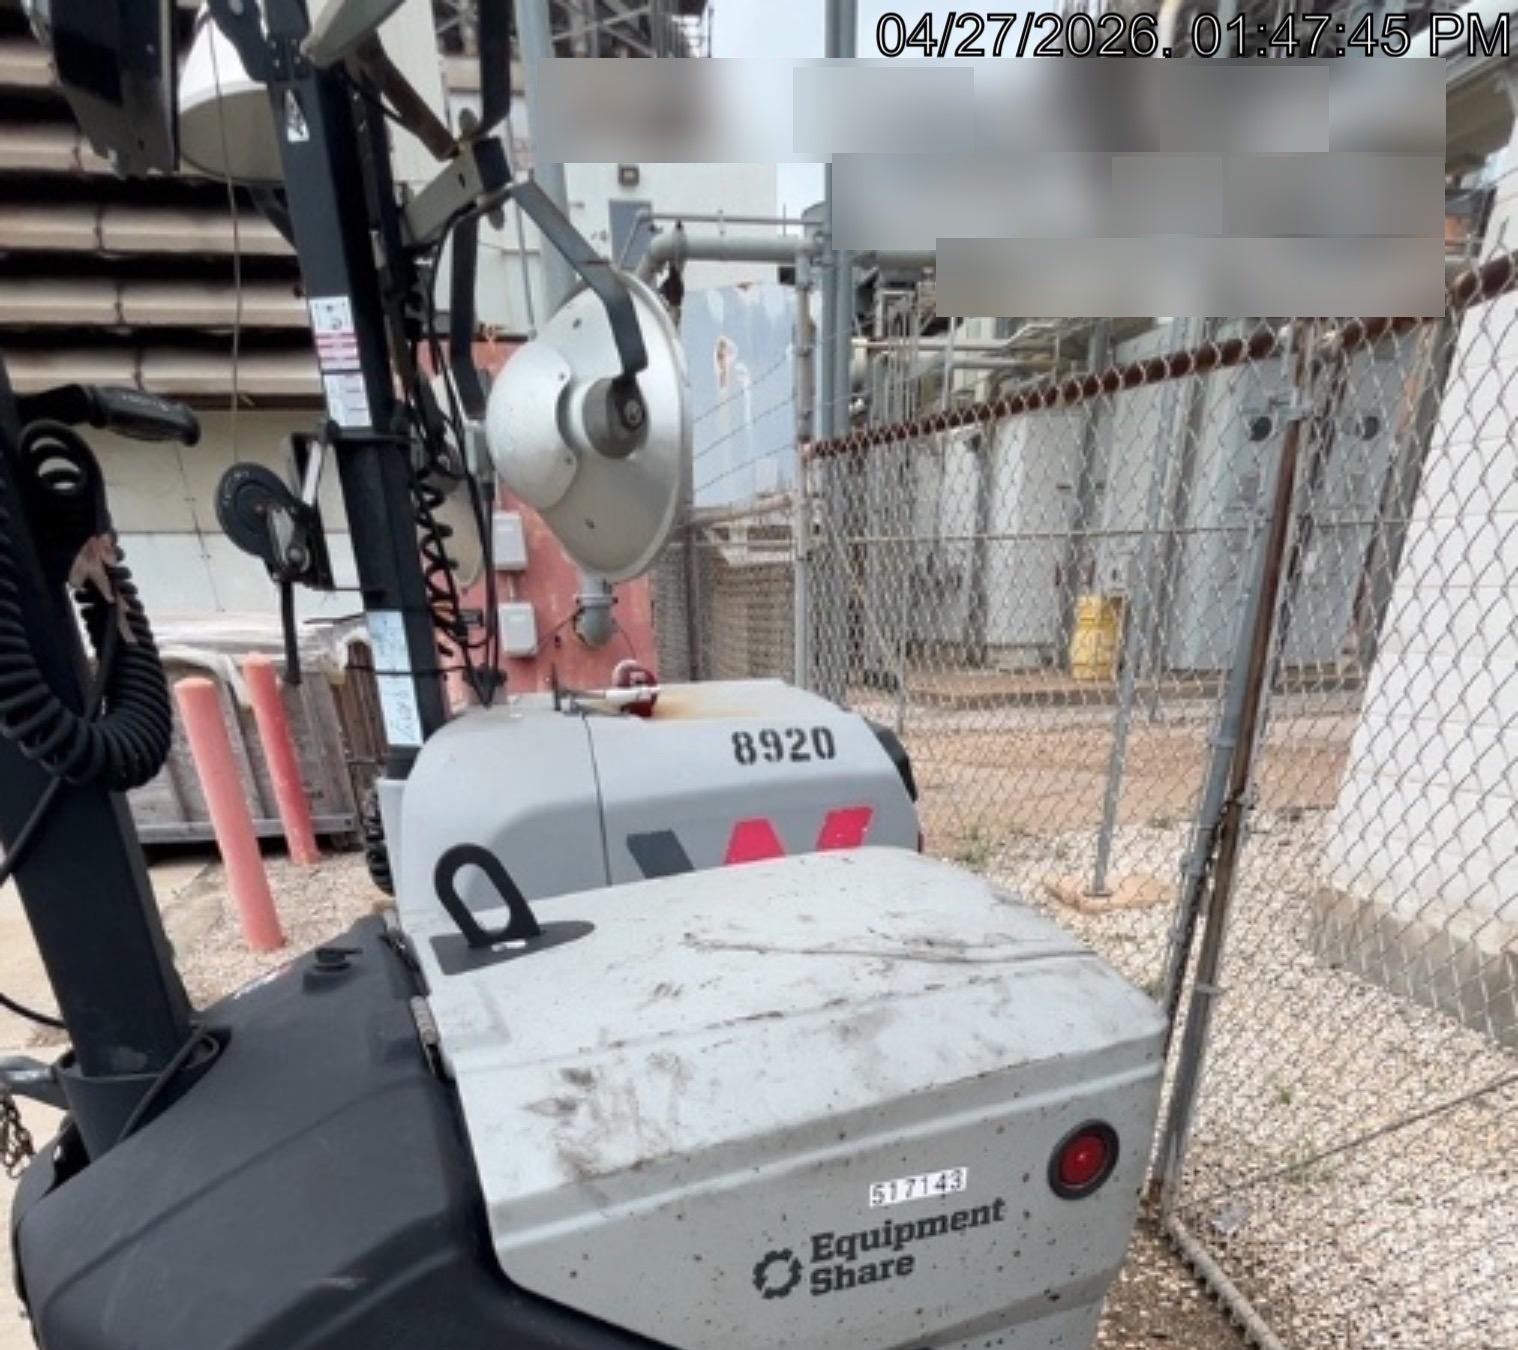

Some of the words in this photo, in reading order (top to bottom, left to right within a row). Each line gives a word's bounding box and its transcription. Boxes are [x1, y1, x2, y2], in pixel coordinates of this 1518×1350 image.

[731, 726, 836, 766] 8920
[872, 1167, 962, 1205] 517143
[810, 1196, 1006, 1262] Equipment
[810, 1254, 915, 1296] Share
